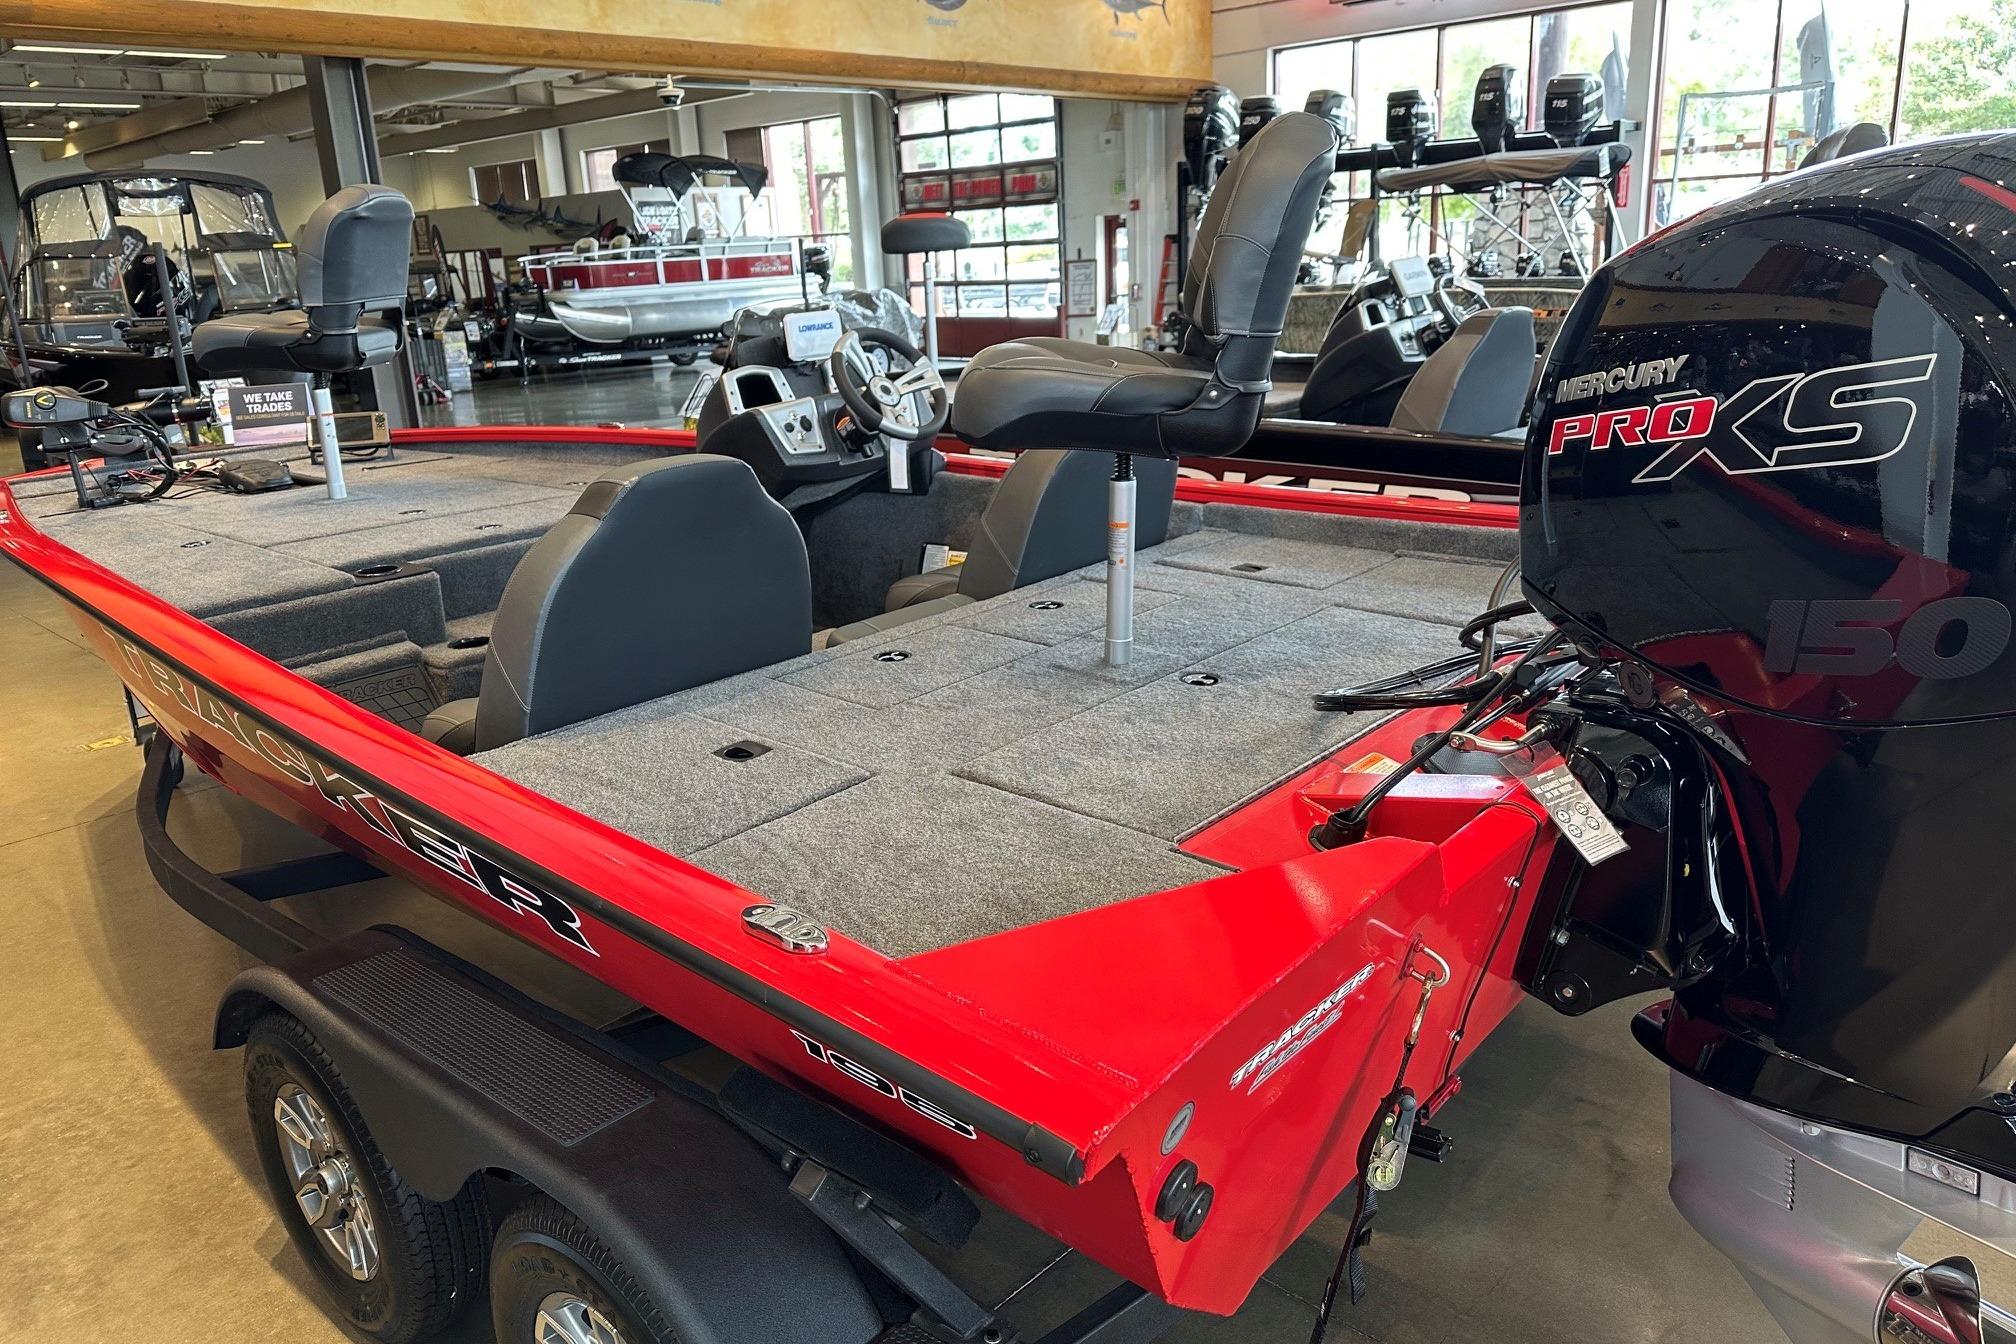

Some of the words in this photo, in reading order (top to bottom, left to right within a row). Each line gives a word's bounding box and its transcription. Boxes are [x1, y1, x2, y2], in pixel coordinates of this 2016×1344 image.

[1478, 91, 1494, 102] 115
[1551, 98, 1568, 109] 115
[798, 321, 834, 333] LOWRANCE
[242, 392, 263, 403] WE
[263, 390, 294, 402] TAKE
[1555, 354, 1690, 404] MERCURY
[246, 401, 293, 414] TRADES
[1548, 396, 1718, 455] PRO
[1632, 353, 1938, 483] XS
[1764, 596, 2012, 680] 150
[101, 622, 600, 957] TRACKER
[1230, 962, 1375, 1089] TRACKER
[789, 1028, 977, 1140] 195
